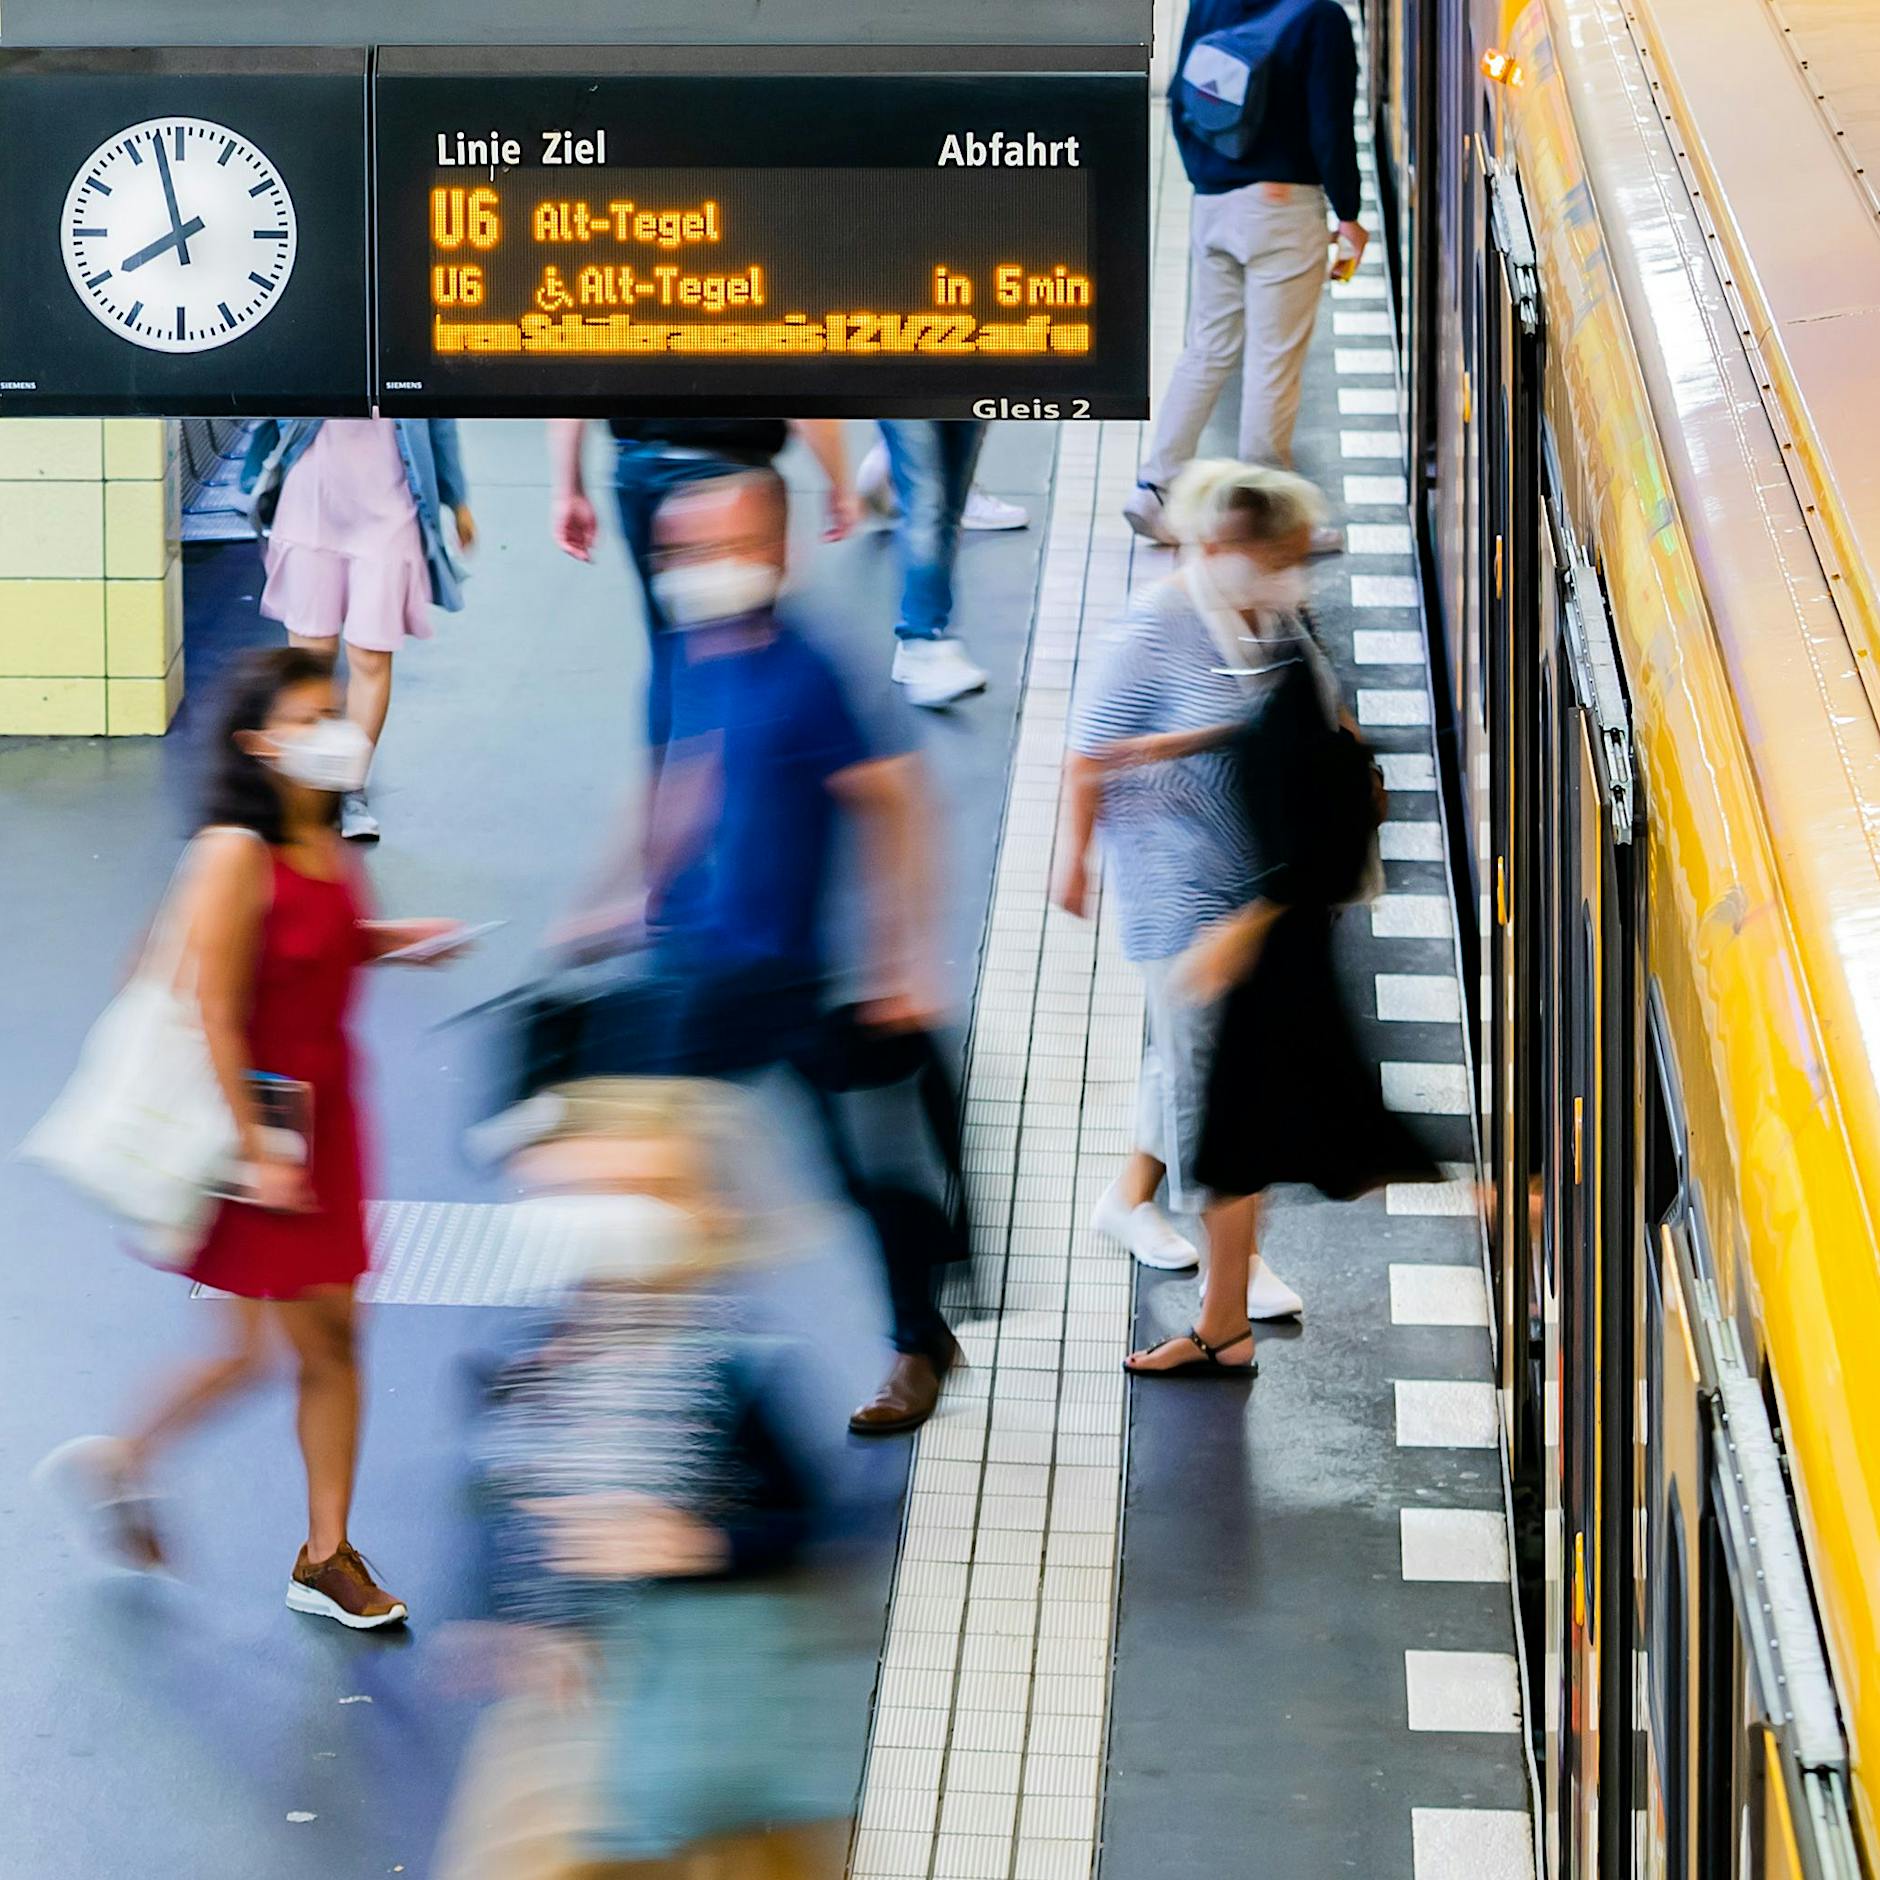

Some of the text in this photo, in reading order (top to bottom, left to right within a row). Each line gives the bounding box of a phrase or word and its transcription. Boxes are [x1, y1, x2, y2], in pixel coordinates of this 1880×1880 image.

[437, 130, 1080, 167] Linie Ziel Abfahrt
[431, 187, 721, 250] U6 Alt-Tegel
[432, 263, 1092, 312] U6 Alt-Tegel in 5 min
[0, 381, 37, 390] SIEMENS
[385, 381, 423, 390] SIEMENS
[972, 398, 1091, 420] Gleis 2
